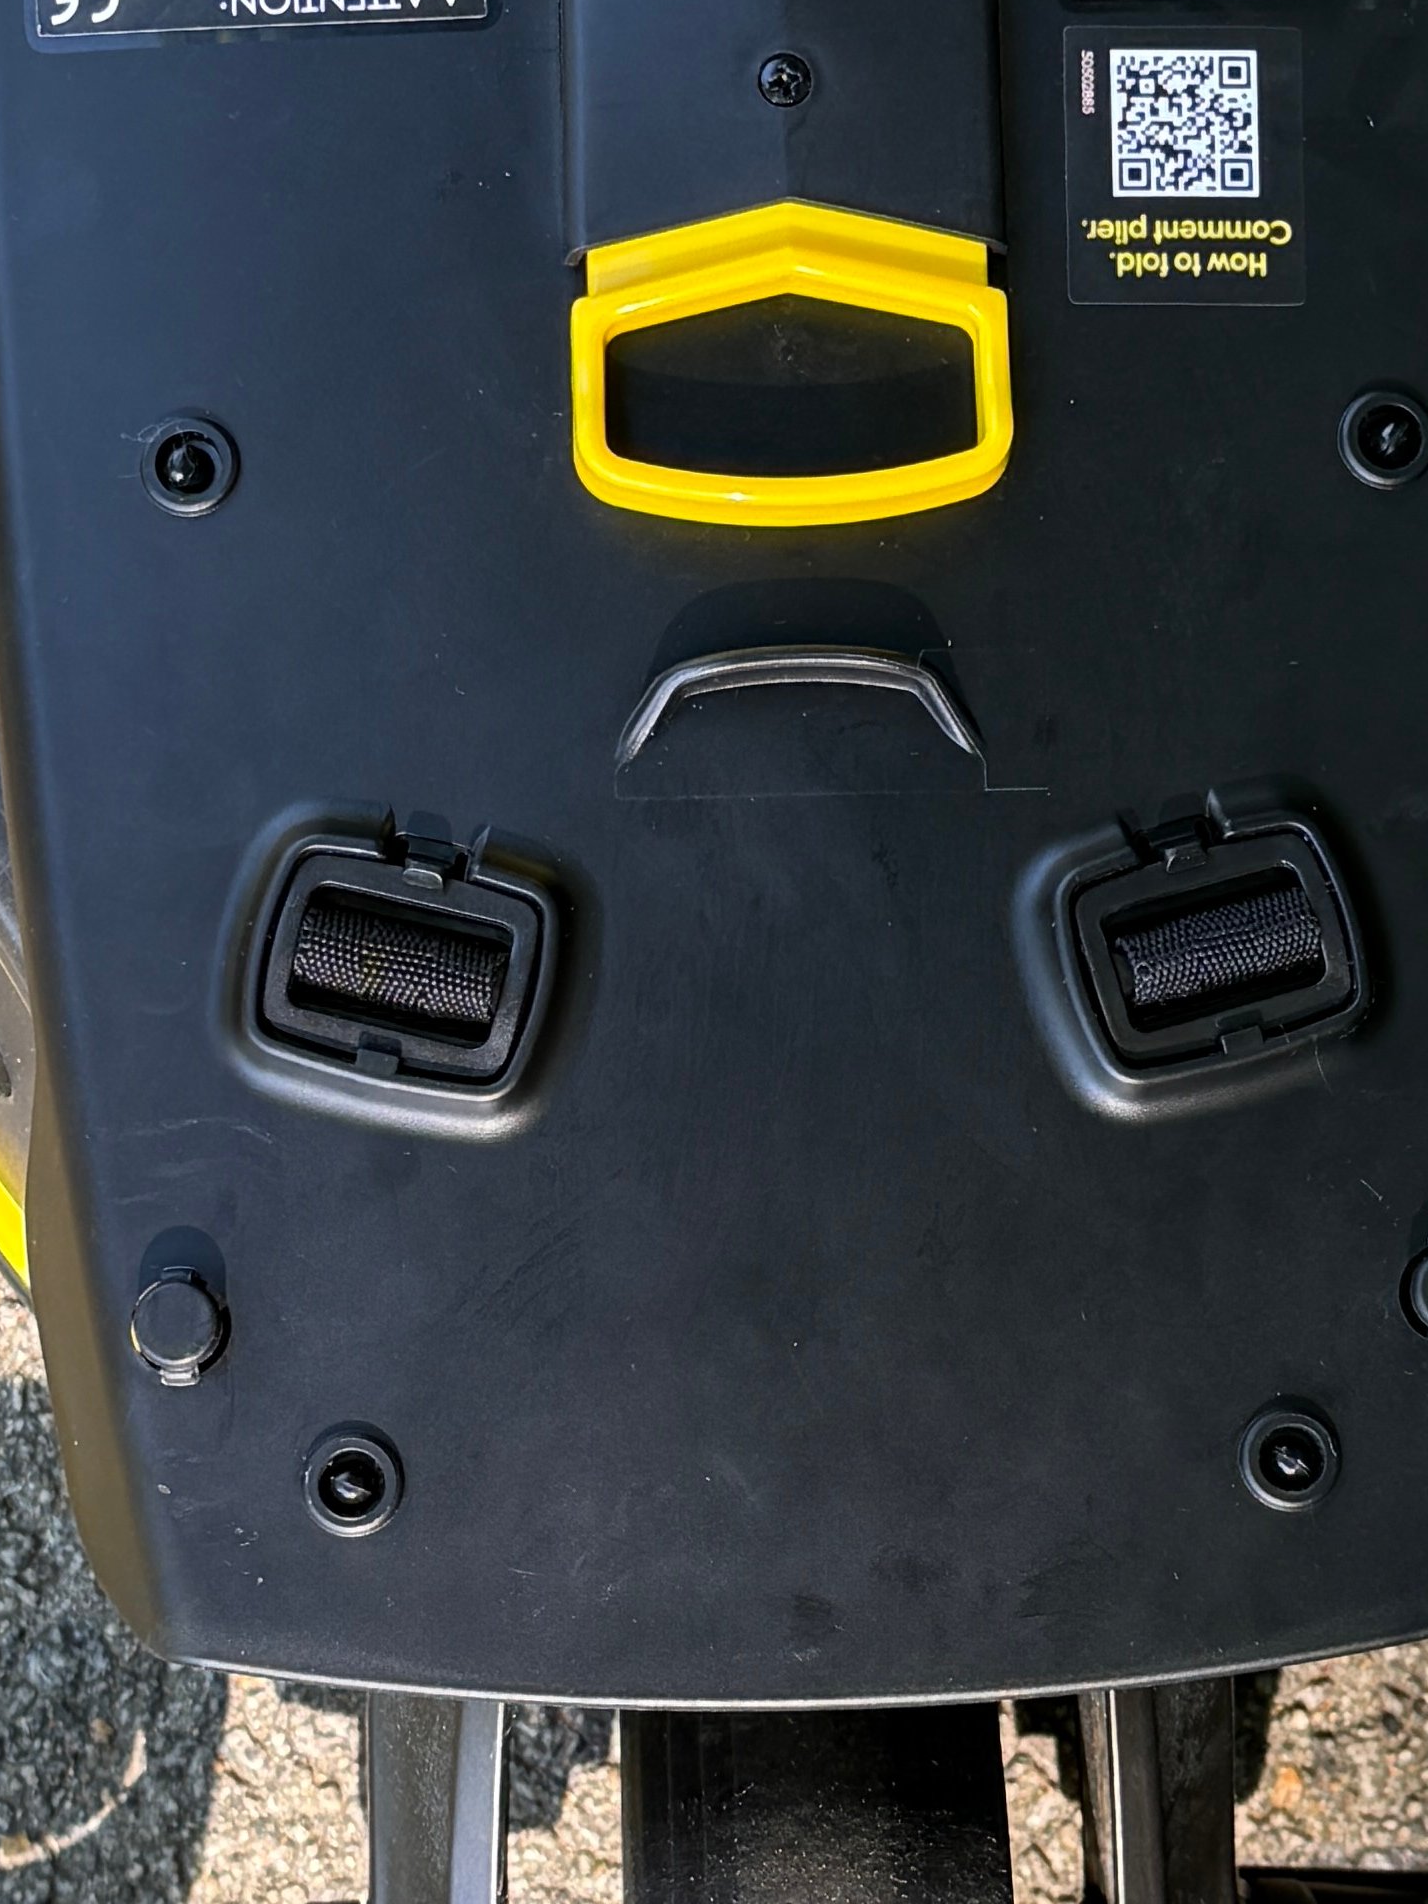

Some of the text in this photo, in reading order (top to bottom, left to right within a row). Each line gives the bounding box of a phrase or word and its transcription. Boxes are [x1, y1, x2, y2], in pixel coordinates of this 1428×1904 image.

[1081, 213, 1292, 244] Comment plier.
[1108, 251, 1267, 277] How to fold.
